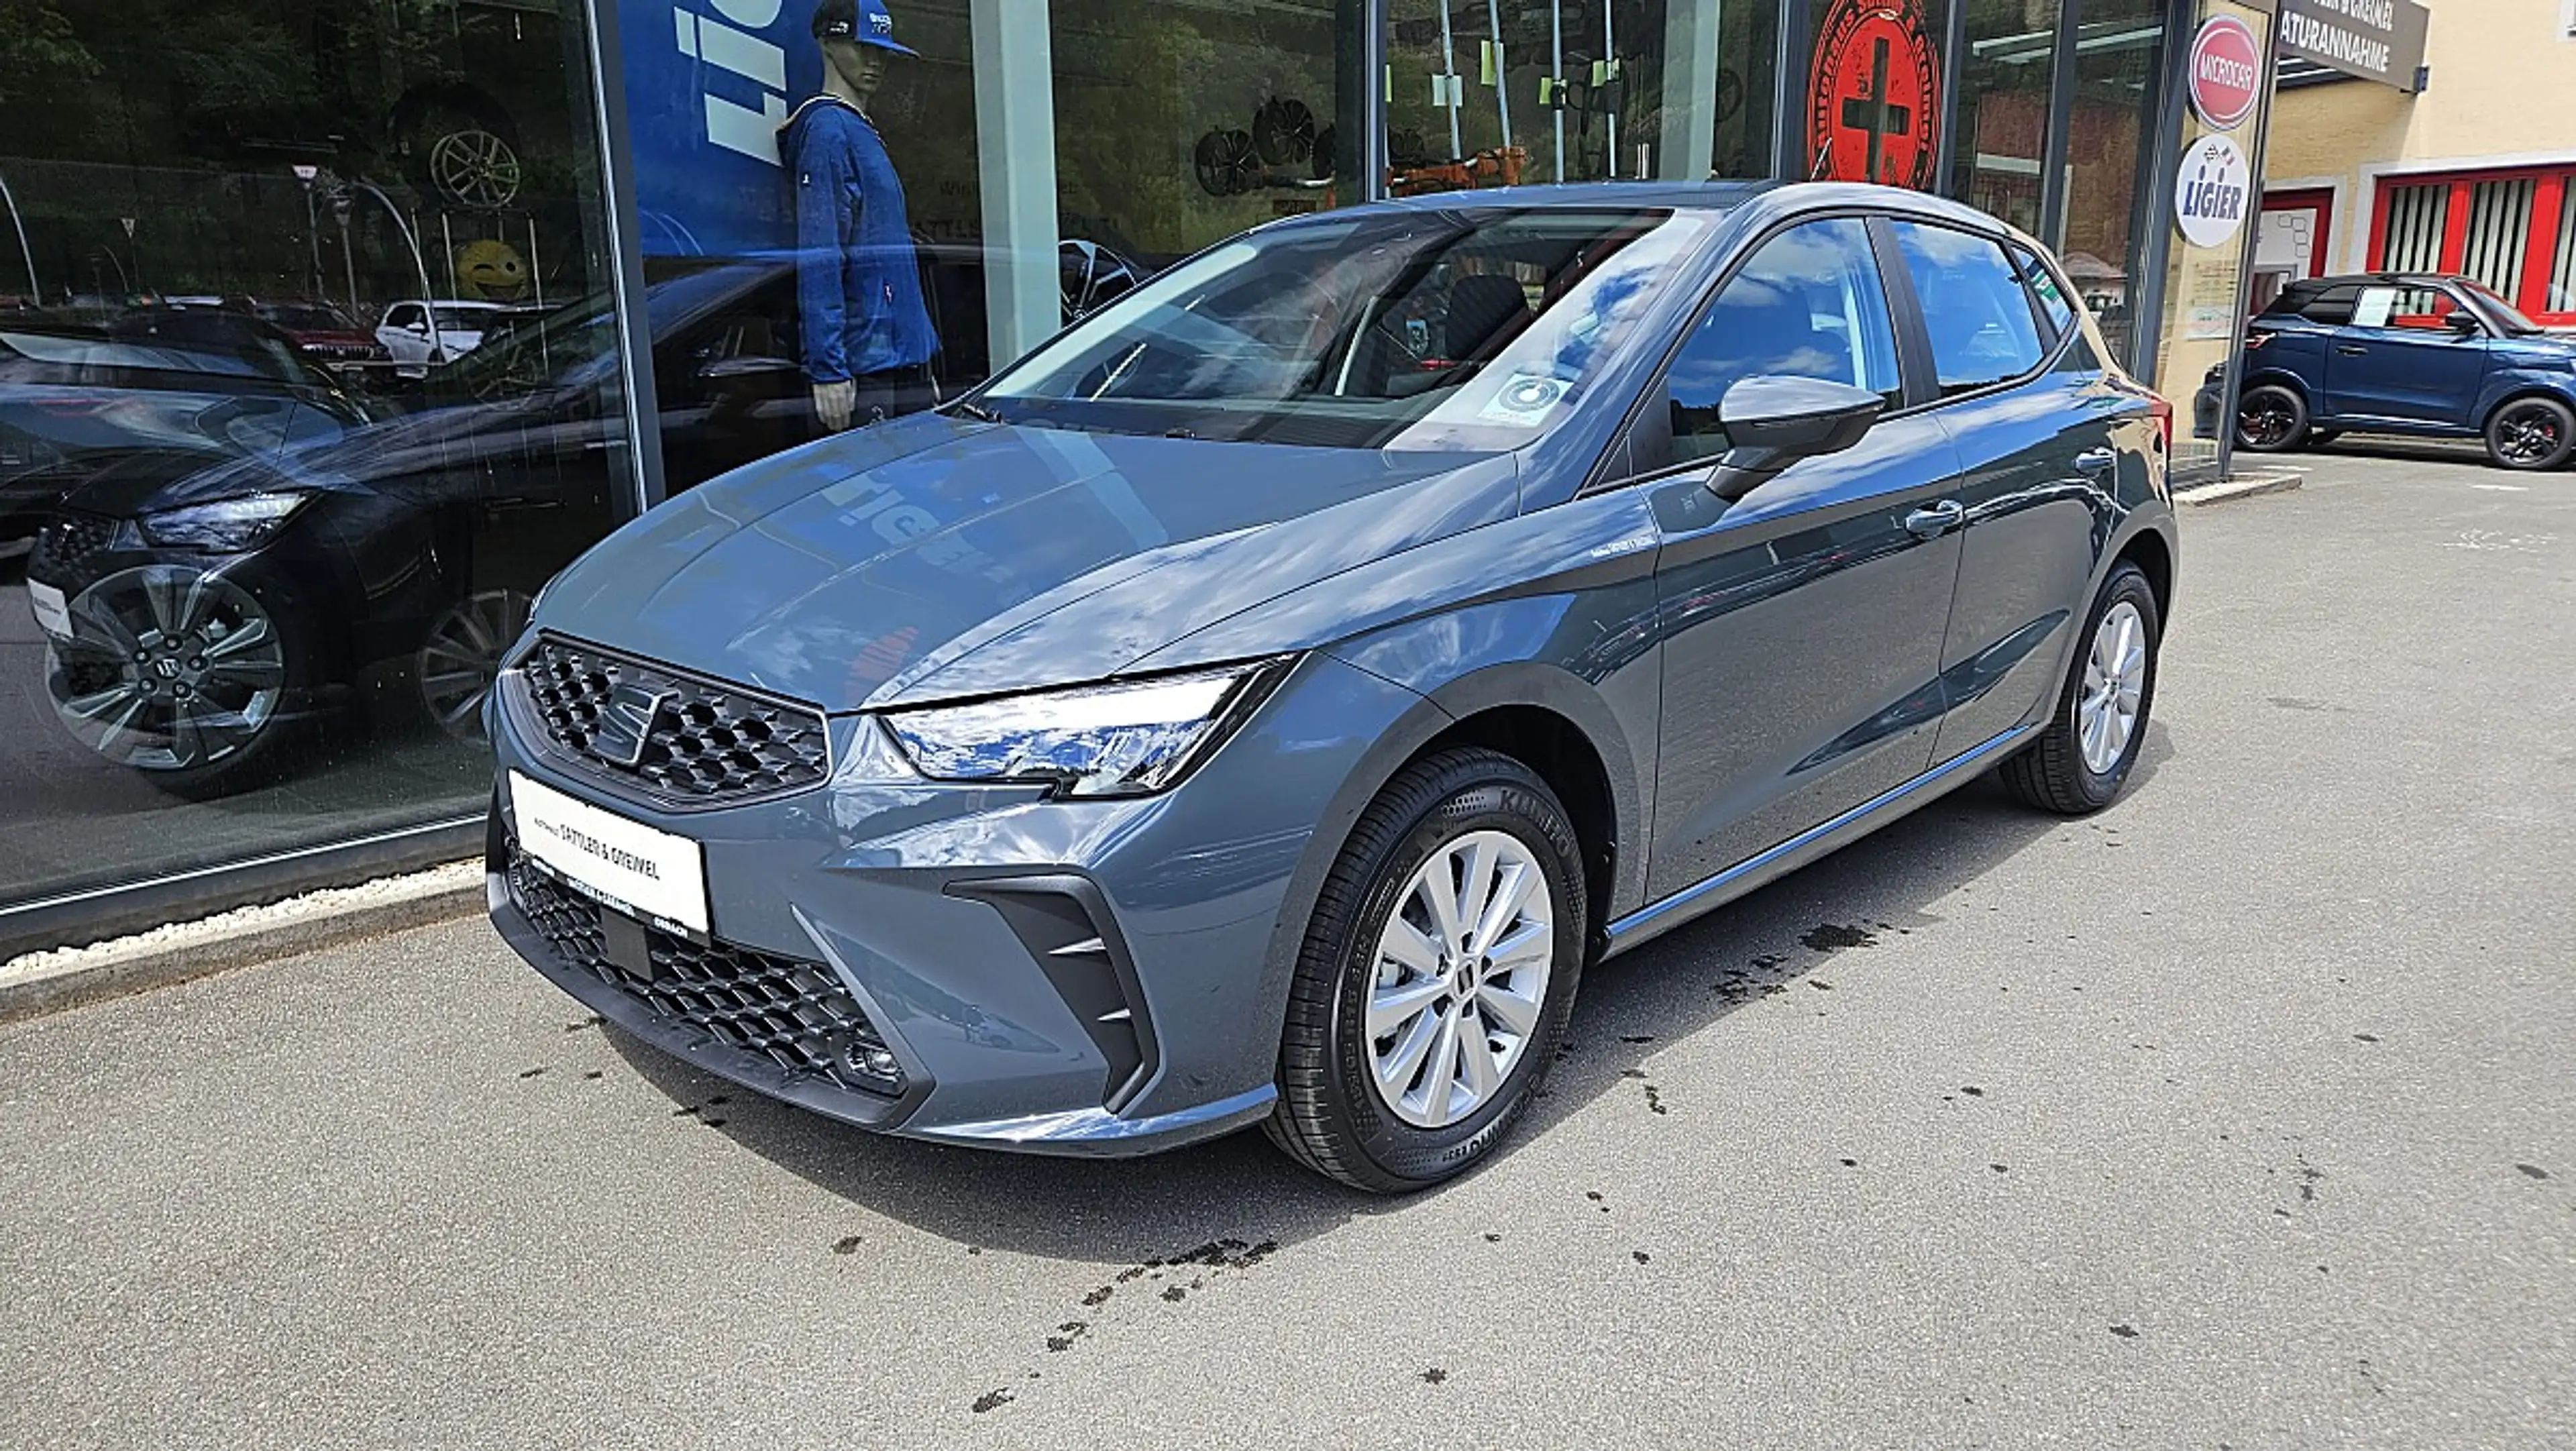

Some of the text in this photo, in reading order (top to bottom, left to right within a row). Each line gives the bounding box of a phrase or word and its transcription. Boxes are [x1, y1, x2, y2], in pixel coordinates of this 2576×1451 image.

[2279, 10, 2391, 72] ATURANNAHME
[559, 824, 600, 858] SATTLER
[601, 843, 609, 861] &
